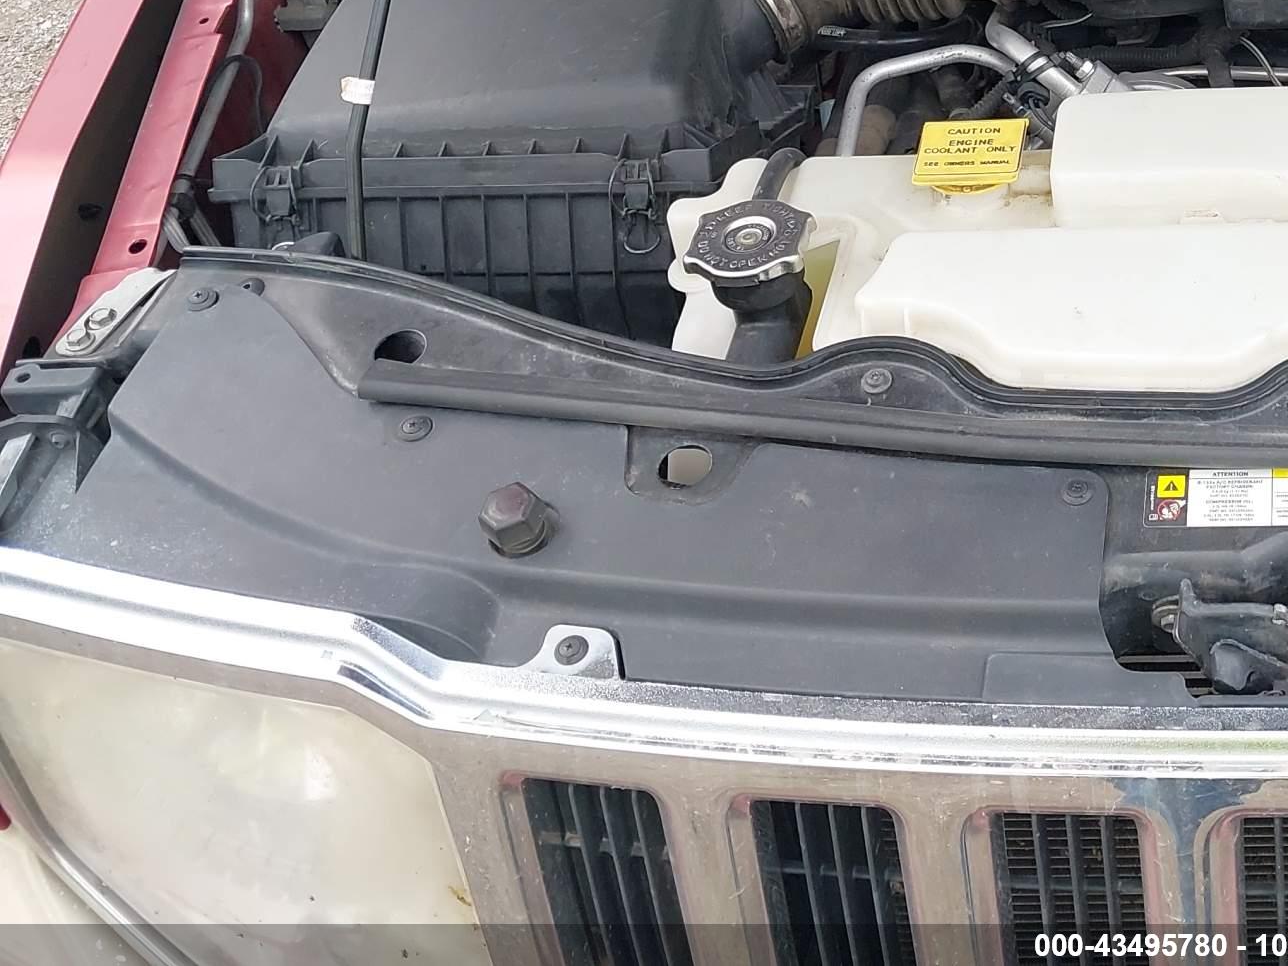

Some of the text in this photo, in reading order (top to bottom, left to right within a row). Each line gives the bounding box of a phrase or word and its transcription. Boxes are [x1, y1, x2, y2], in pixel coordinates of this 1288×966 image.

[947, 126, 1001, 136] CAUTION
[948, 138, 995, 147] ENGINE
[924, 145, 1017, 155] COOLANT ONLY
